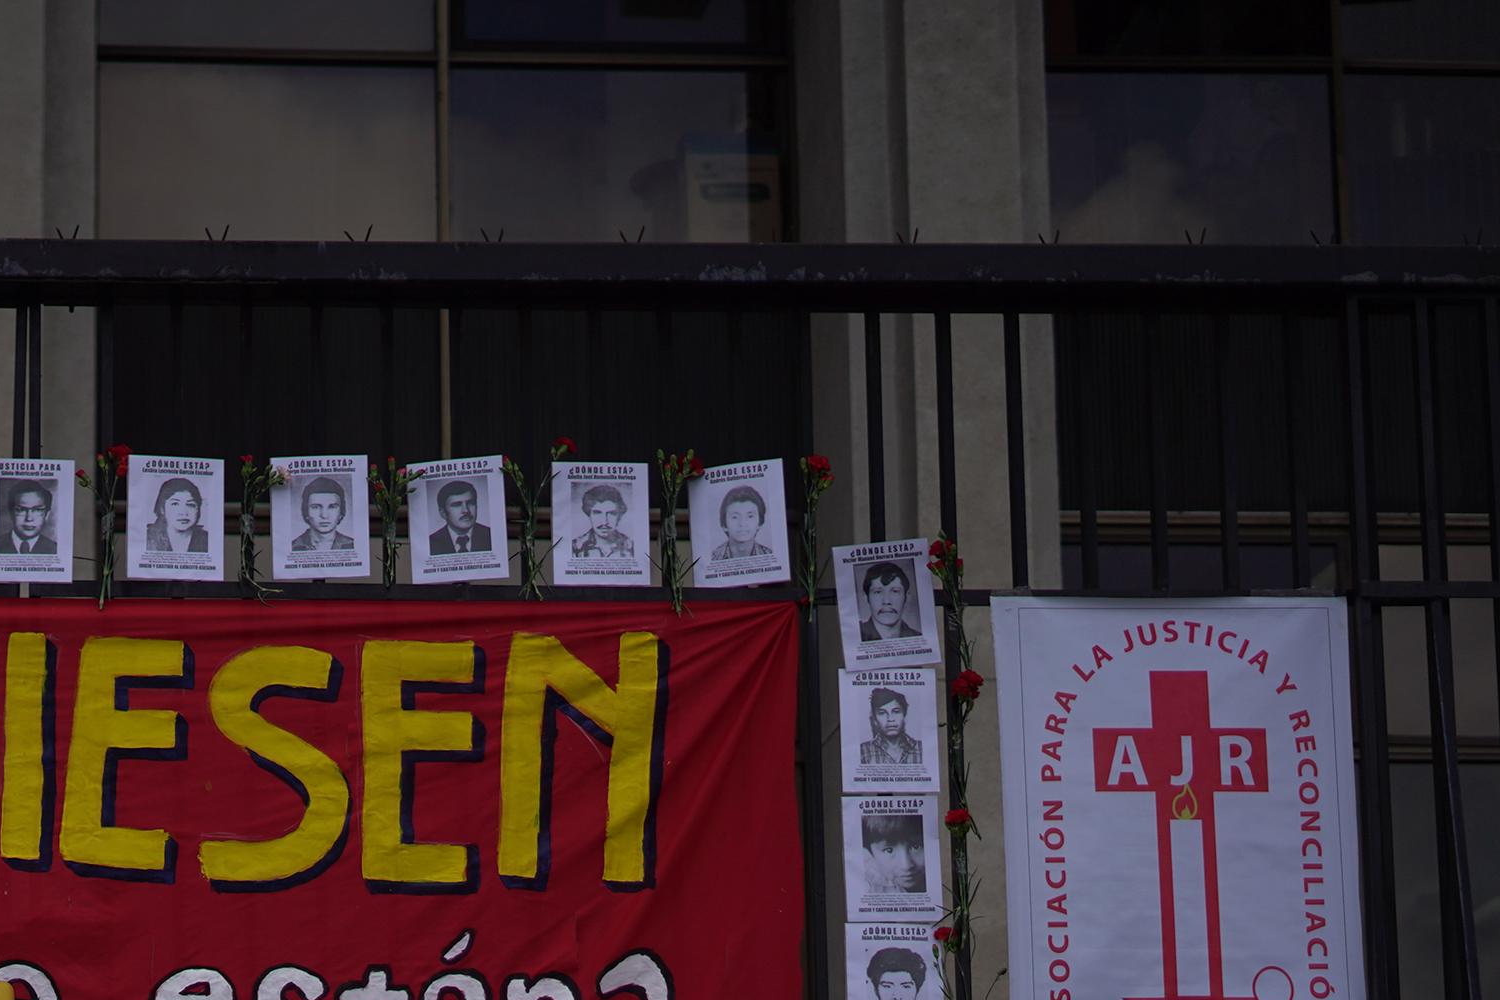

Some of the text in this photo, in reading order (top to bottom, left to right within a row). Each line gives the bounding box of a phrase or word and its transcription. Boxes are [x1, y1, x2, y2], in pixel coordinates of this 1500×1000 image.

[1040, 690, 1078, 782] PARA
[1072, 643, 1113, 682] LA
[1122, 620, 1270, 674] JUSTICIA
[1275, 673, 1297, 696] Y
